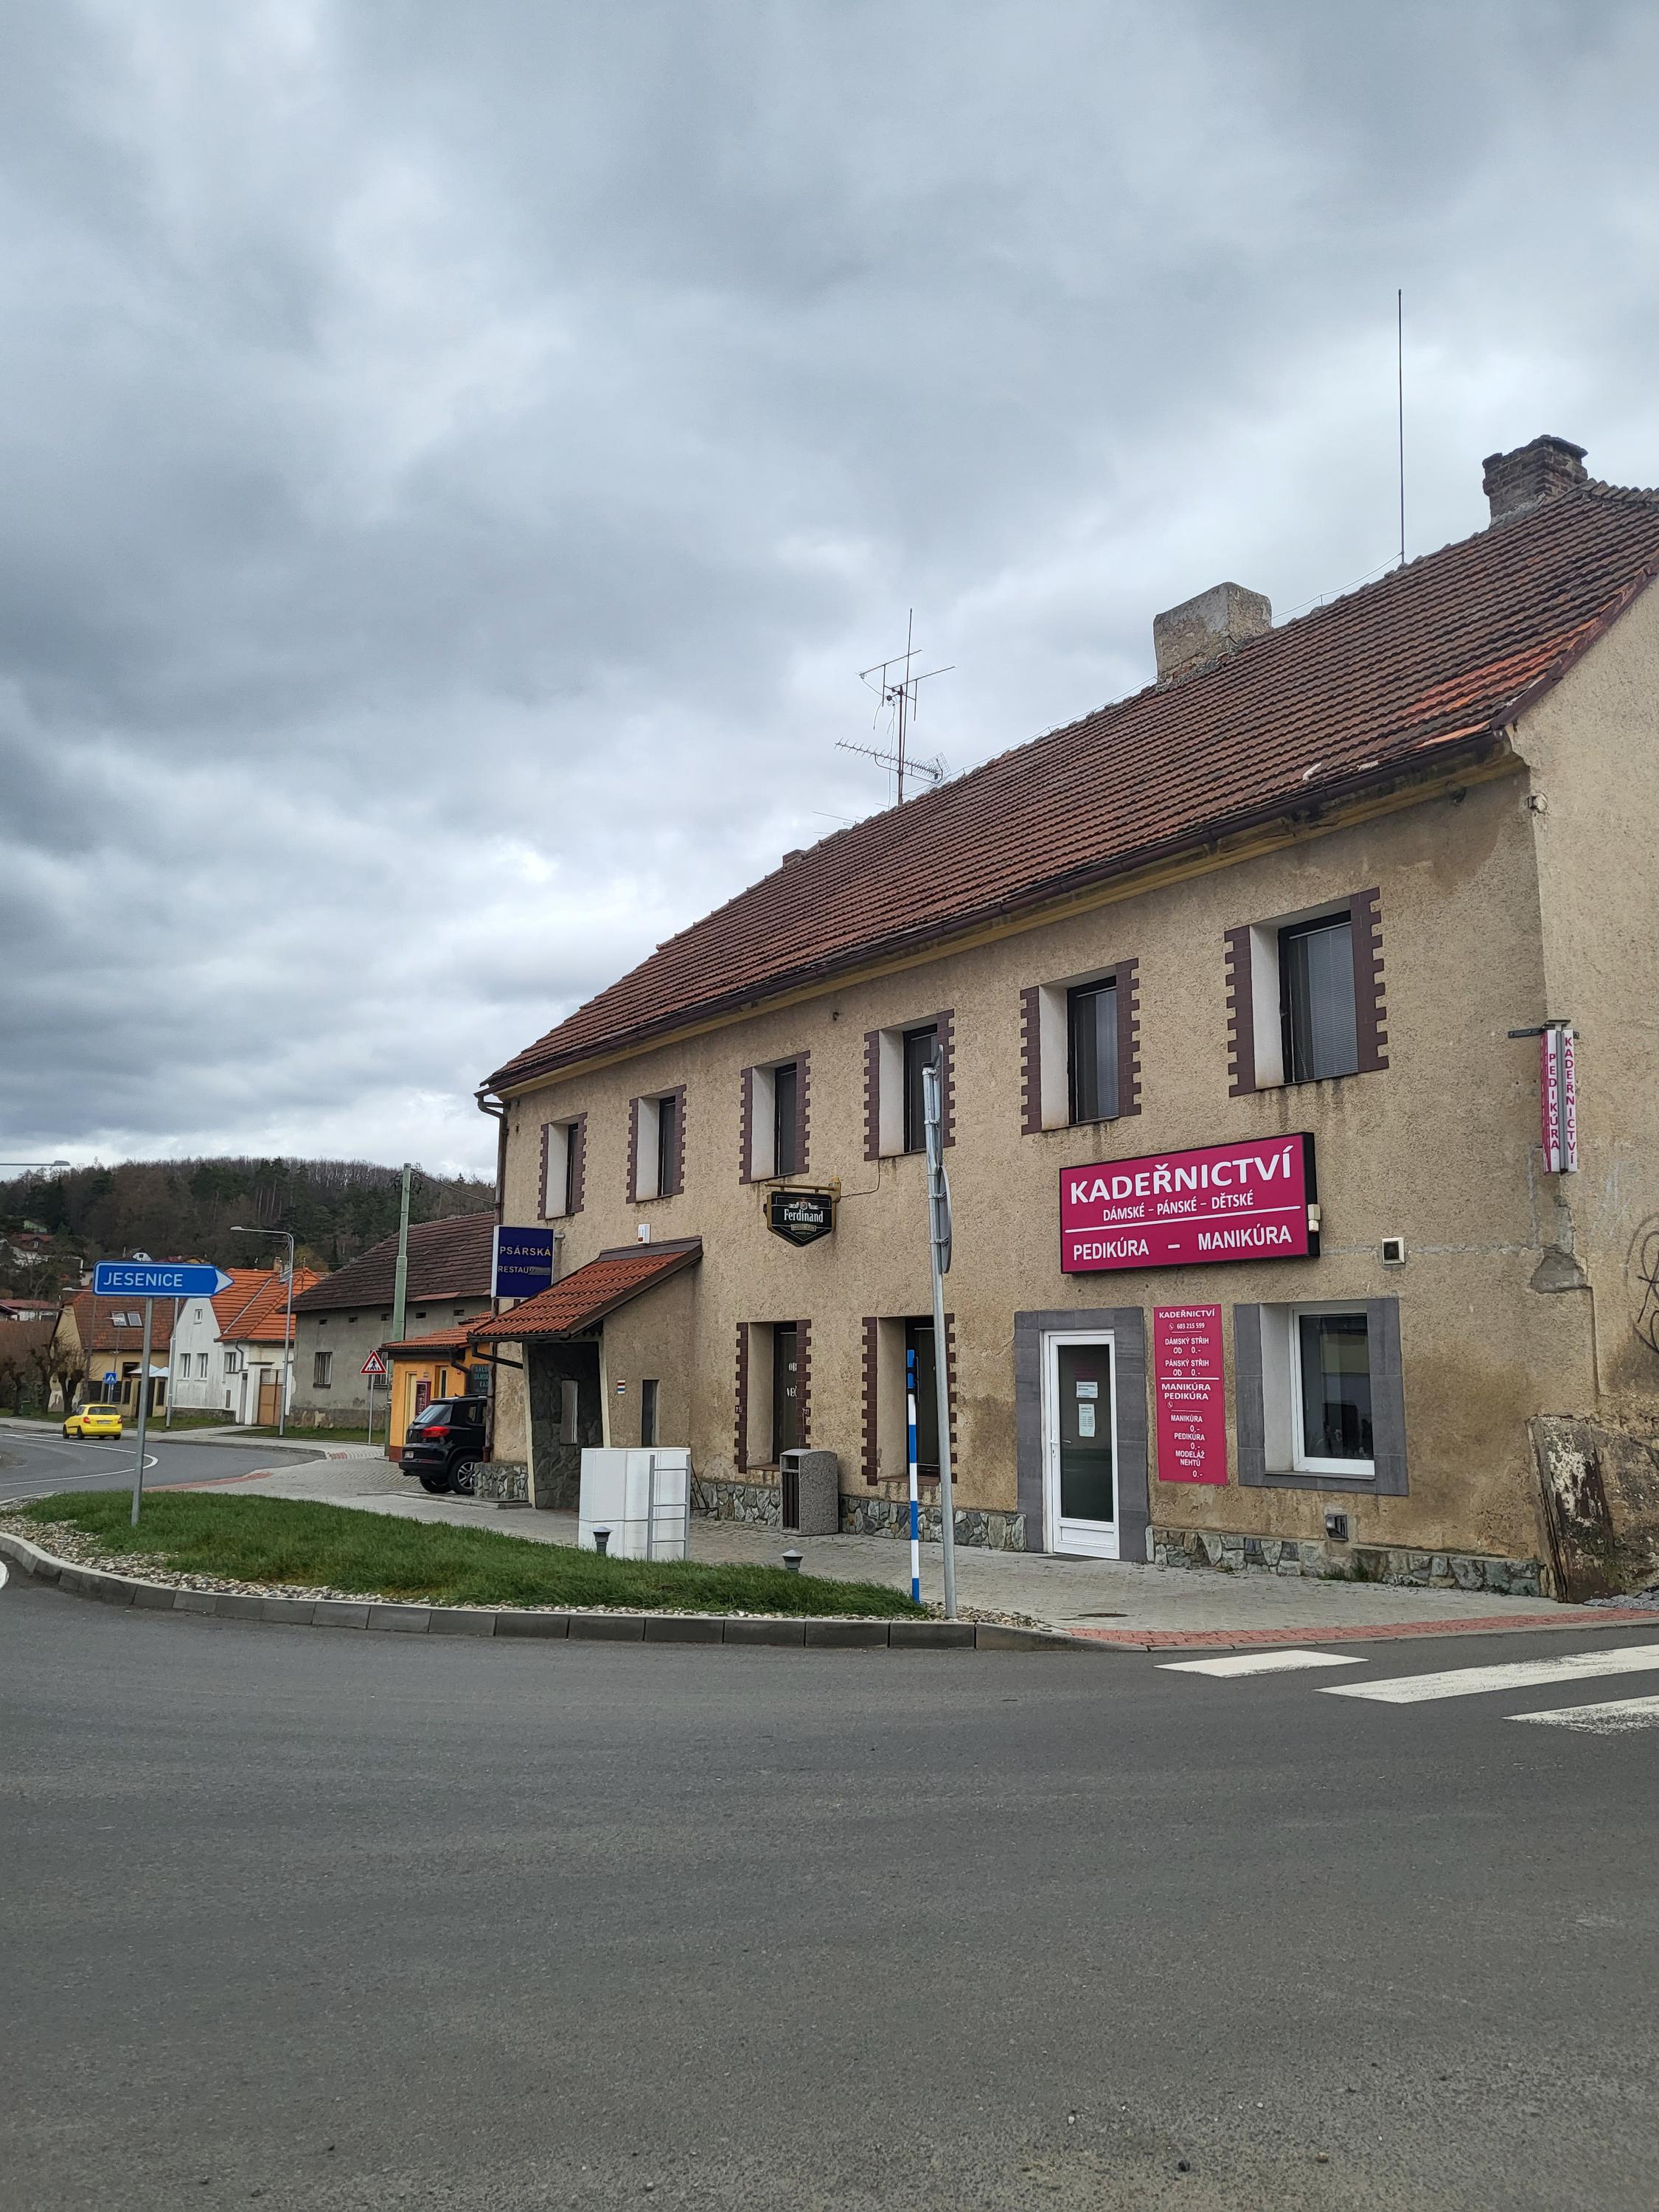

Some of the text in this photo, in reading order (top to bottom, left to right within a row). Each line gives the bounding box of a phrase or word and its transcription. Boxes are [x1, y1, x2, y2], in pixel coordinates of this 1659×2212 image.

[1549, 1054, 1559, 1150] PEDIKÚRA
[1565, 1037, 1576, 1164] KADEŘNICTVÍ
[1071, 1145, 1294, 1205] KADEŘNICTVÍ
[1103, 1203, 1145, 1221] DÁMSKÉ
[1157, 1196, 1197, 1215] PÁNSKÉ
[1211, 1189, 1253, 1209] DĚTSKÉ
[784, 1208, 824, 1222] Ferdinand
[1074, 1237, 1150, 1261] PEDIKÚRA
[1198, 1223, 1293, 1251] MANIKÚRA
[499, 1245, 552, 1256] PSÁRSKÁ
[498, 1265, 535, 1274] RESTAU
[103, 1272, 184, 1287] JESENICE
[1159, 1308, 1216, 1318] KADEŘNICTVÍ
[1165, 1336, 1209, 1345] DÁMSKÝ STŘIH
[1165, 1358, 1209, 1367] PÁNSKÝ STŘIH
[1161, 1382, 1211, 1391] MANIKÚRA
[1164, 1391, 1208, 1400] PEDIKÚRA
[1170, 1413, 1203, 1422] MANIKÚRA
[1174, 1432, 1205, 1441] PEDIKÚRA
[1175, 1450, 1205, 1458] MODELÁŽ
